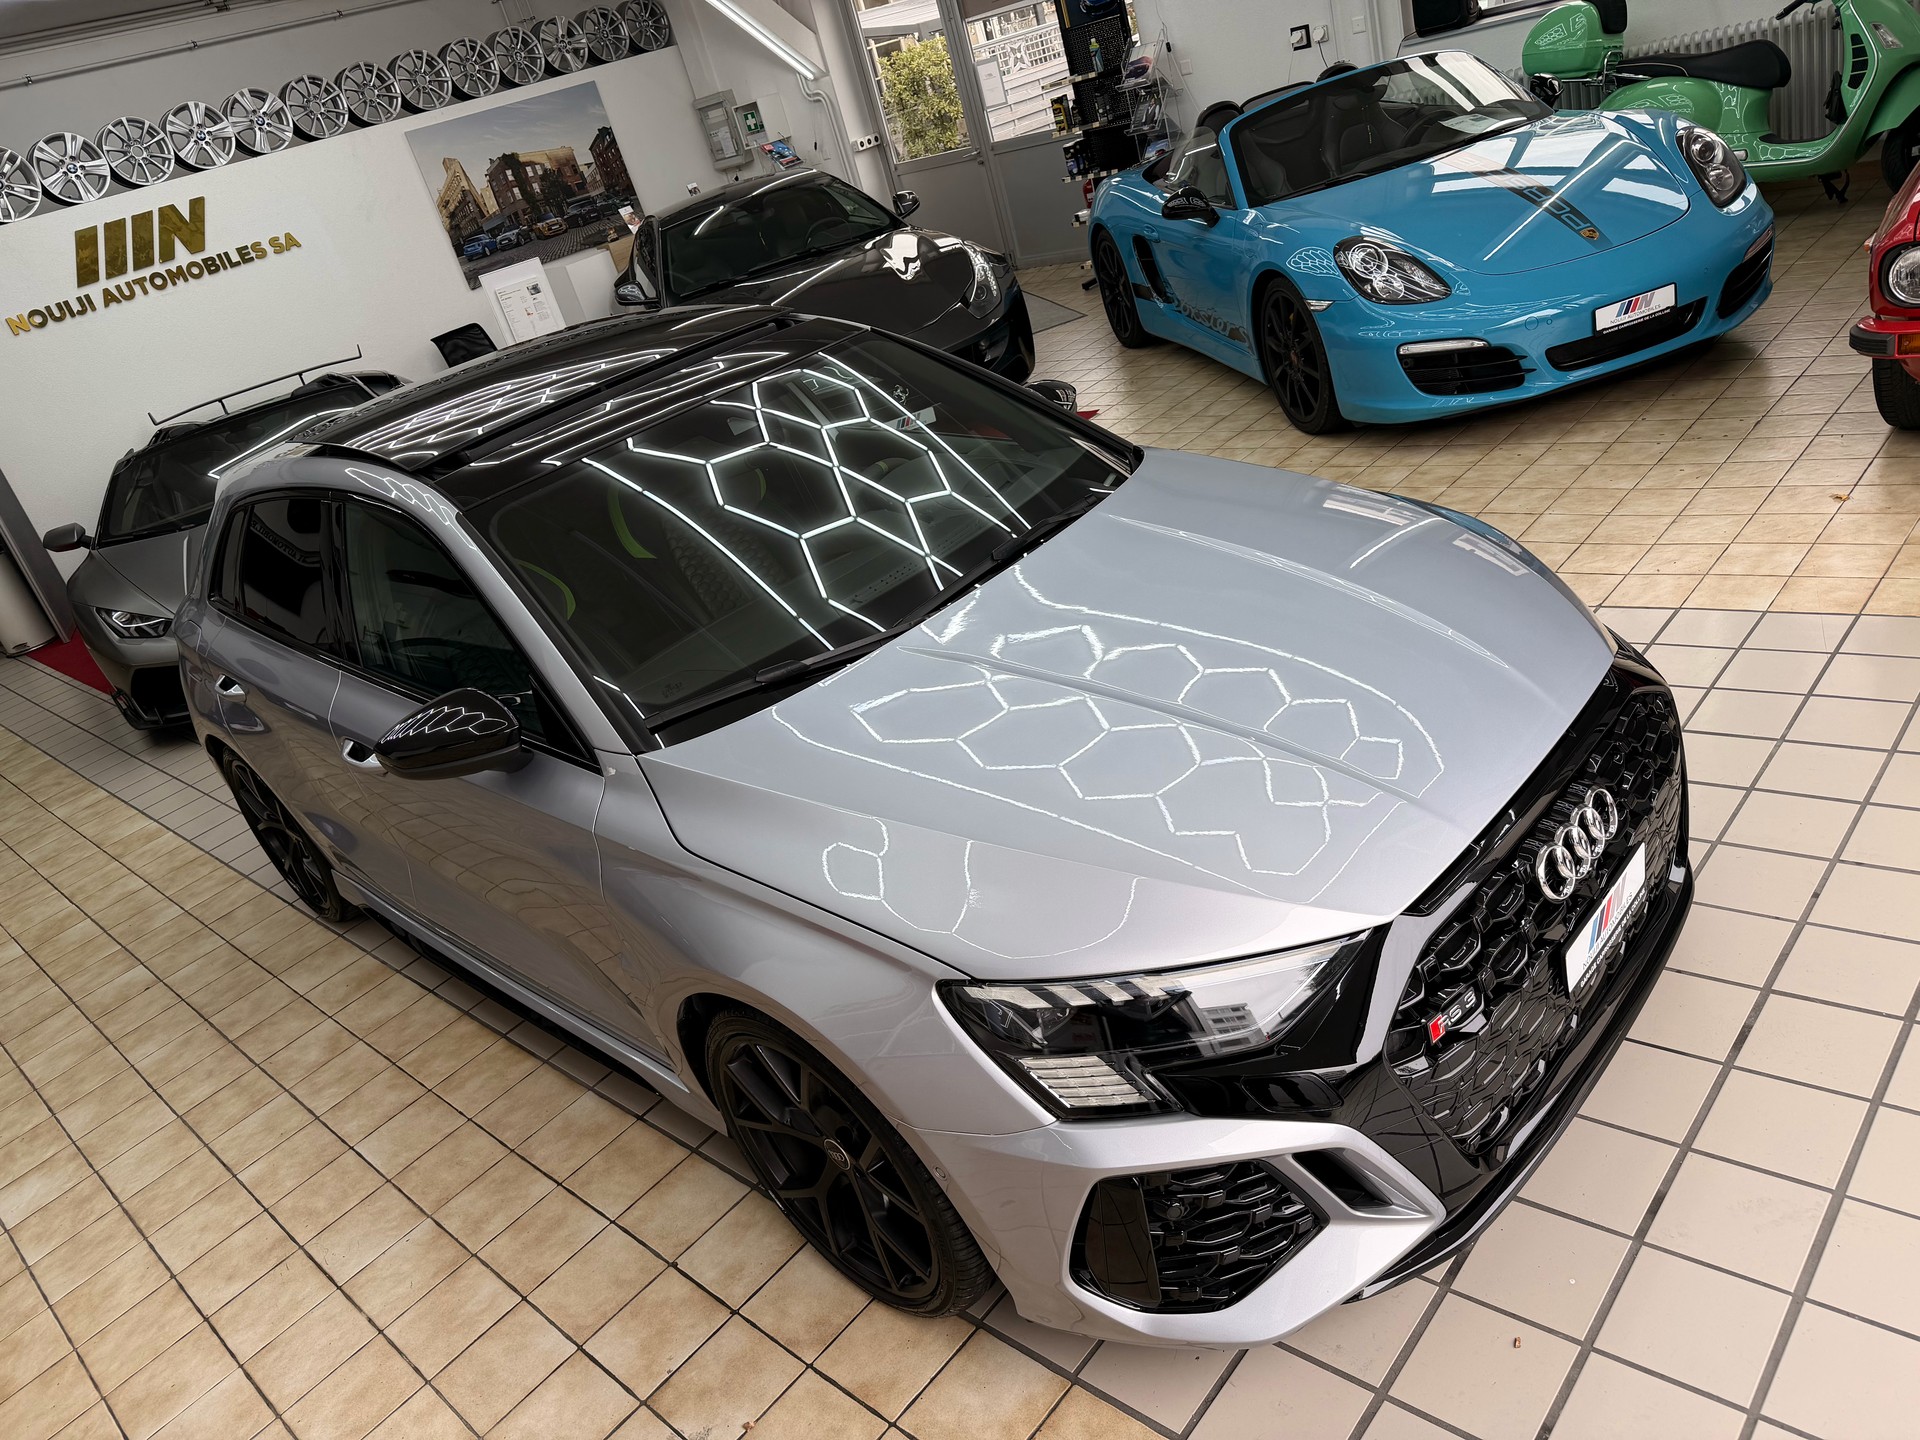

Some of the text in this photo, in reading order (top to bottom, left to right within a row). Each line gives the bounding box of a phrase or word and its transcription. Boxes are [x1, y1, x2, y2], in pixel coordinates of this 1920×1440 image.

[5, 231, 302, 336] NOUIJI AUTOMOBILES SA
[1627, 303, 1661, 320] AUTOMOBILES
[1580, 962, 1597, 988] GARAGE
[1631, 887, 1646, 912] COLLINE
[1436, 990, 1476, 1034] RS 3
